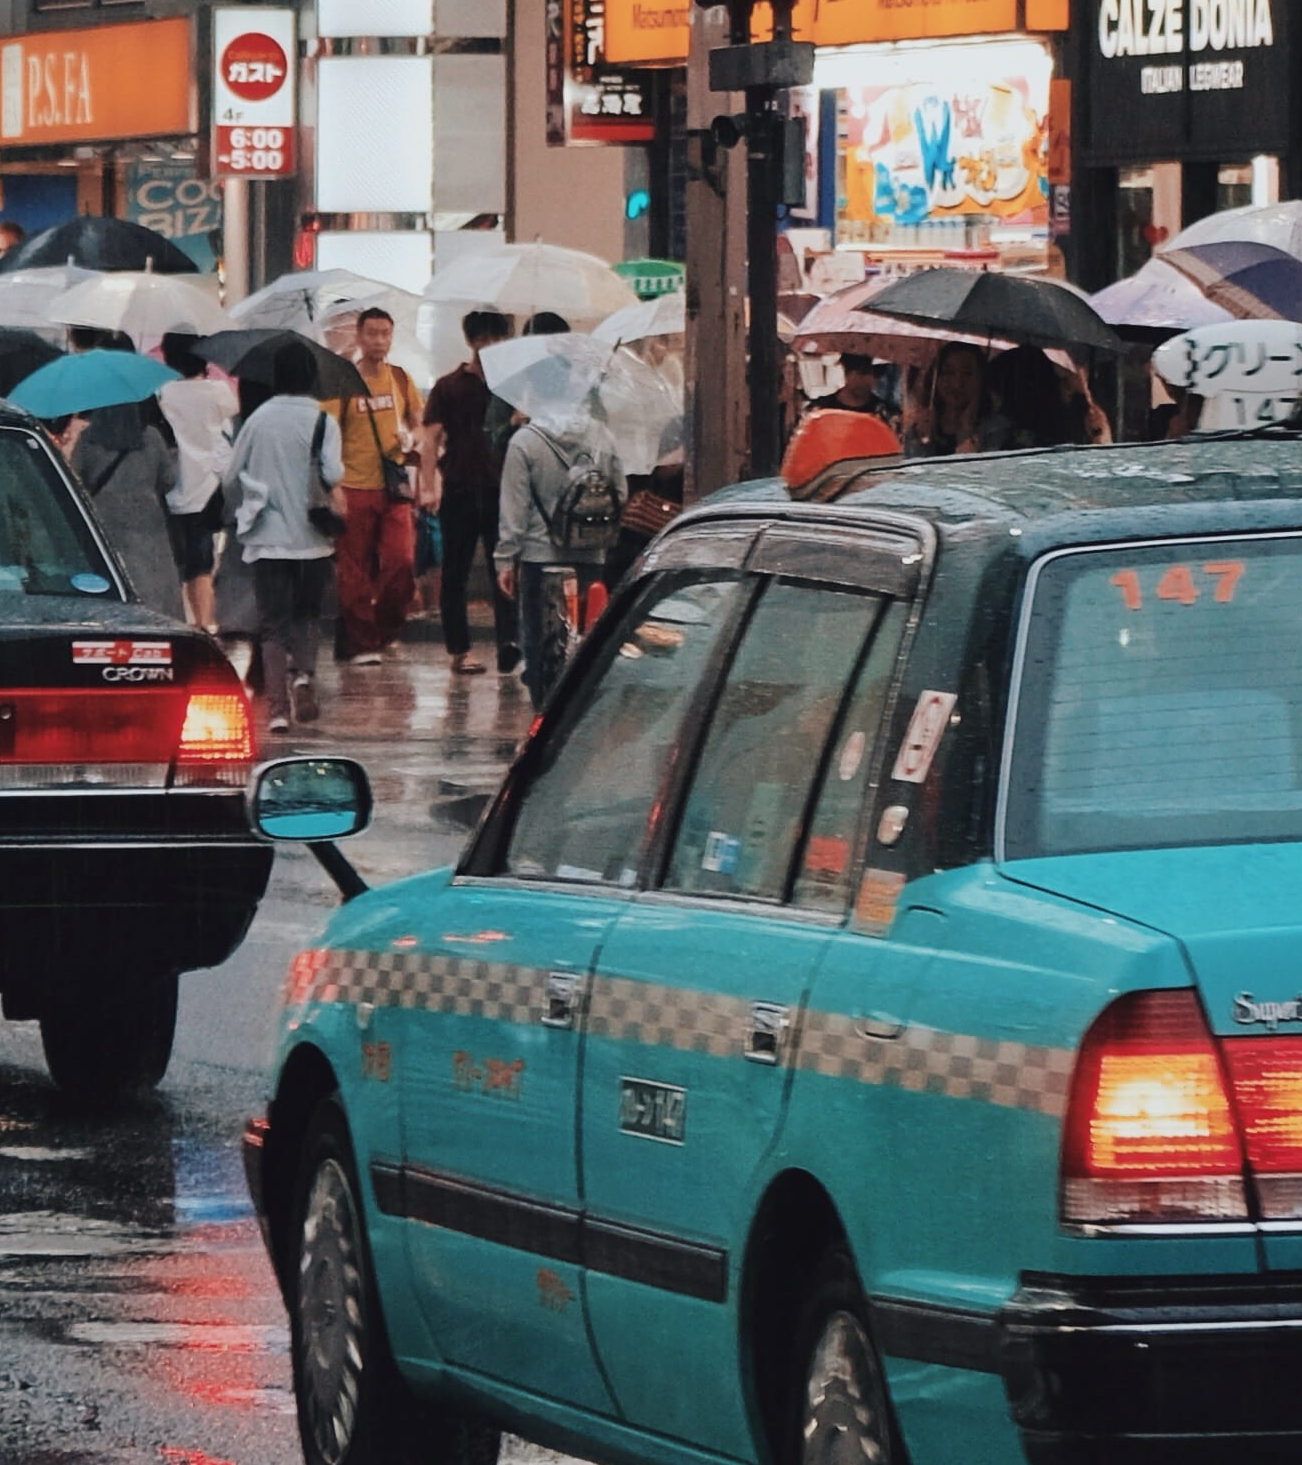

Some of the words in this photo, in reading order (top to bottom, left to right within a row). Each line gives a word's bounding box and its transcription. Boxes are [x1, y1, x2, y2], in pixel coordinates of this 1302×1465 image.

[228, 61, 283, 84] ガスト
[27, 51, 94, 128] P.S.FA
[230, 128, 284, 150] 6:00
[1108, 560, 1248, 612] 147
[102, 667, 175, 682] CROWN
